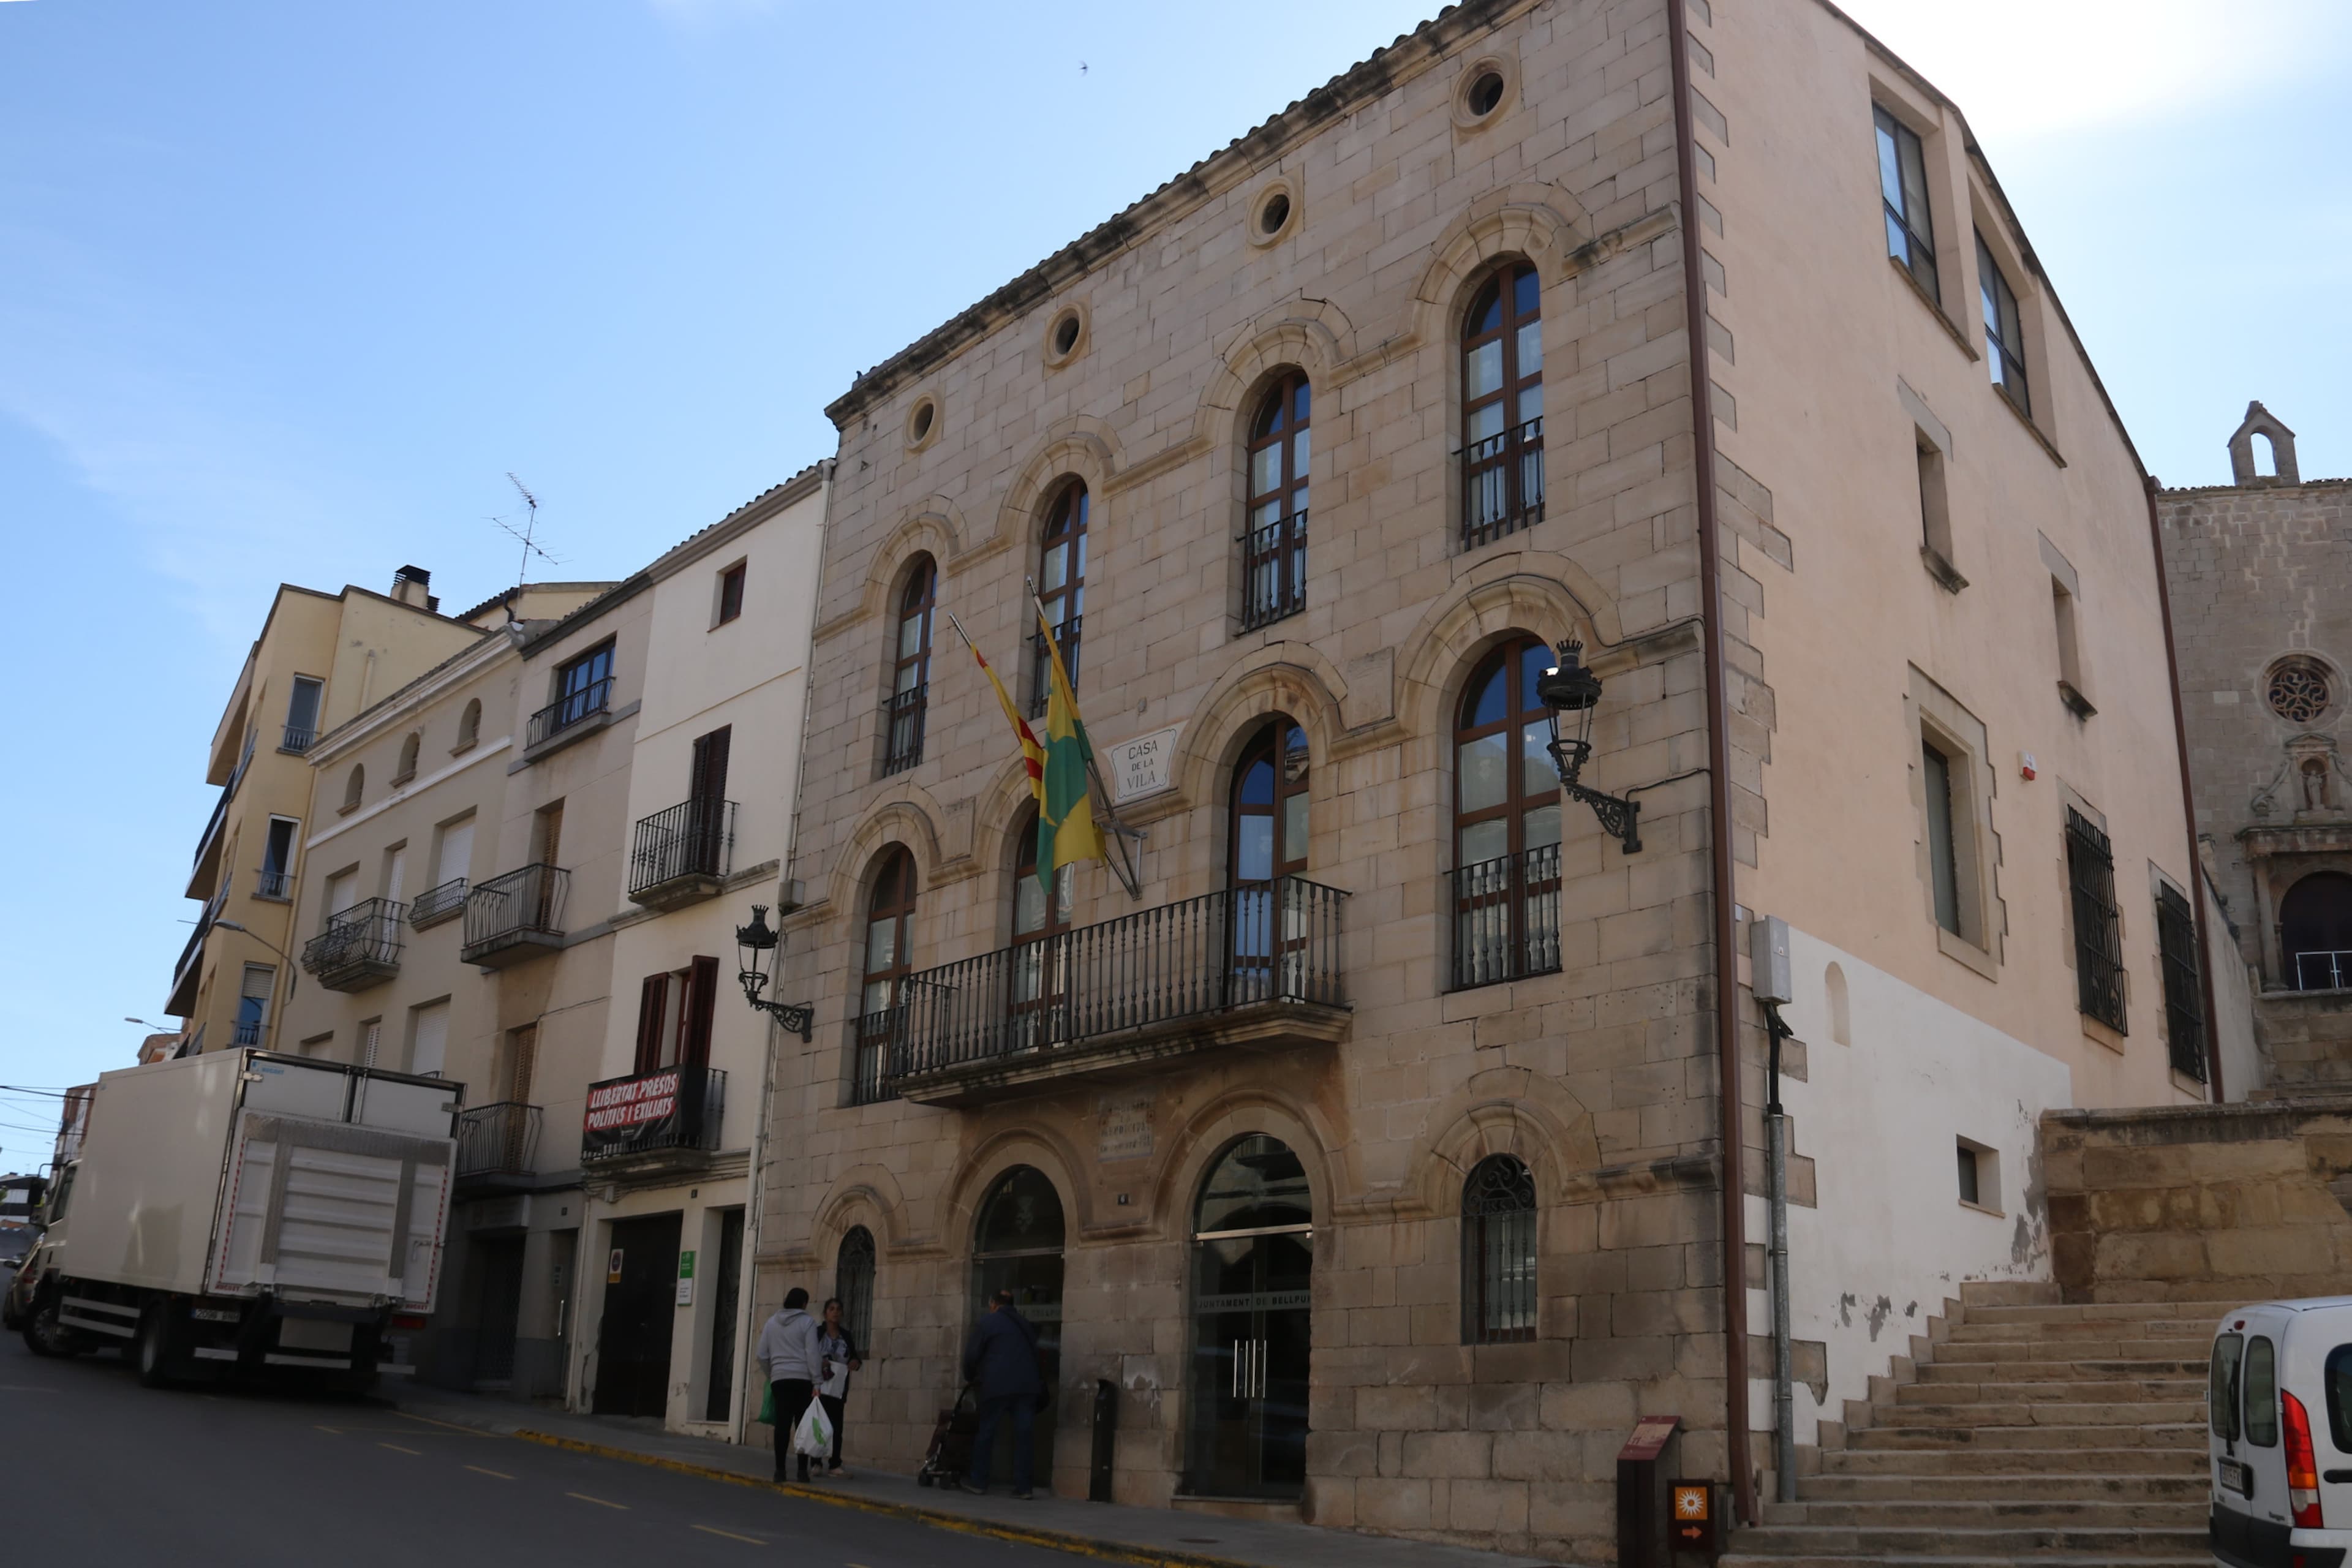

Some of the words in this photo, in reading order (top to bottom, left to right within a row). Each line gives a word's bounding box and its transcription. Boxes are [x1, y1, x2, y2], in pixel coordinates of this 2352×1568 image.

[1128, 740, 1158, 760] CASA
[1132, 761, 1141, 771] DE
[1144, 758, 1154, 767] LA
[1127, 771, 1156, 789] VILA
[590, 1082, 638, 1109] LLIBERTAT
[638, 1073, 677, 1099] PRESOS
[633, 1096, 674, 1121] EXILIATS
[1197, 1298, 1250, 1309] JUNTAMENT
